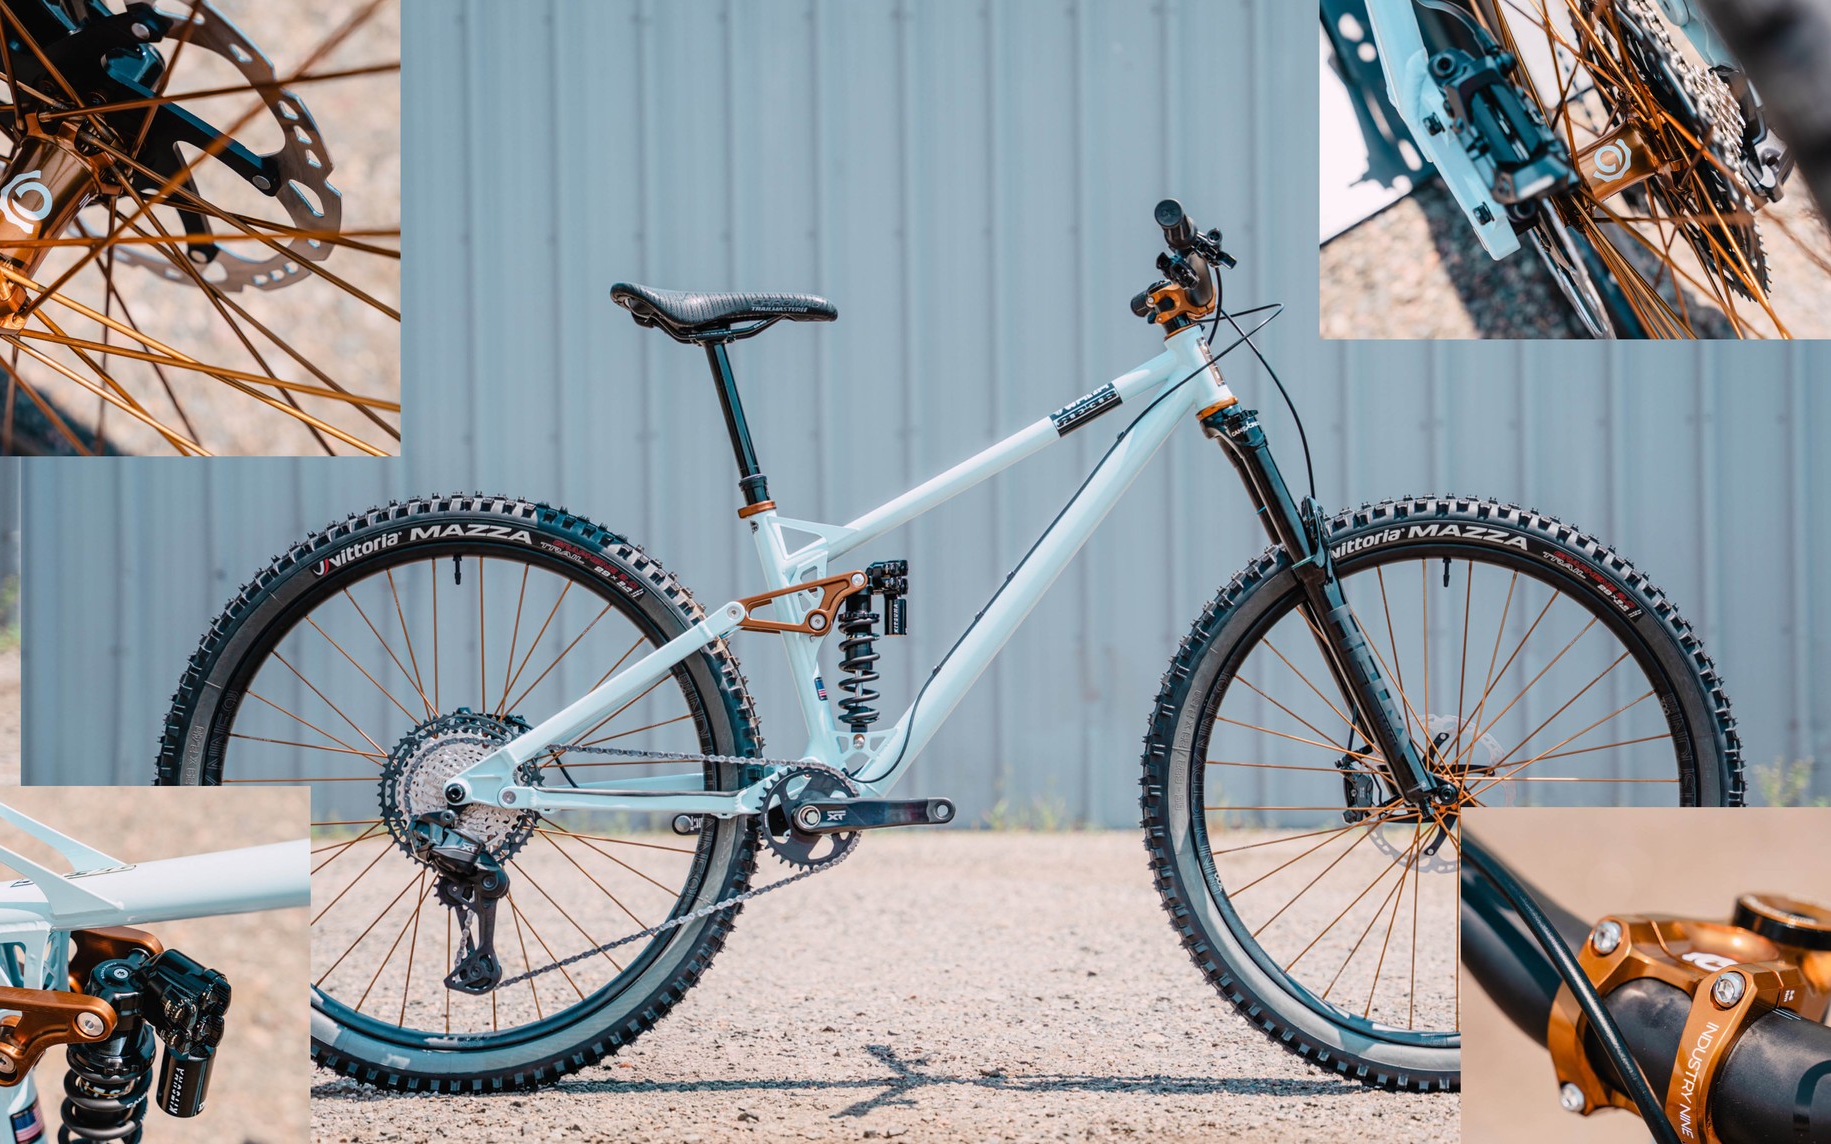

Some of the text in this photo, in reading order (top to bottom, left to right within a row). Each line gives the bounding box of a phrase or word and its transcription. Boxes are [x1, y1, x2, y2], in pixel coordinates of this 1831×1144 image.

[328, 523, 533, 567] vittoria MAZZA
[540, 541, 585, 565] TRAIL
[1331, 524, 1529, 560] vittoria MAZZA
[169, 1067, 185, 1115] KITSUMA
[1679, 1021, 1720, 1140] INDUSTRY NINE
